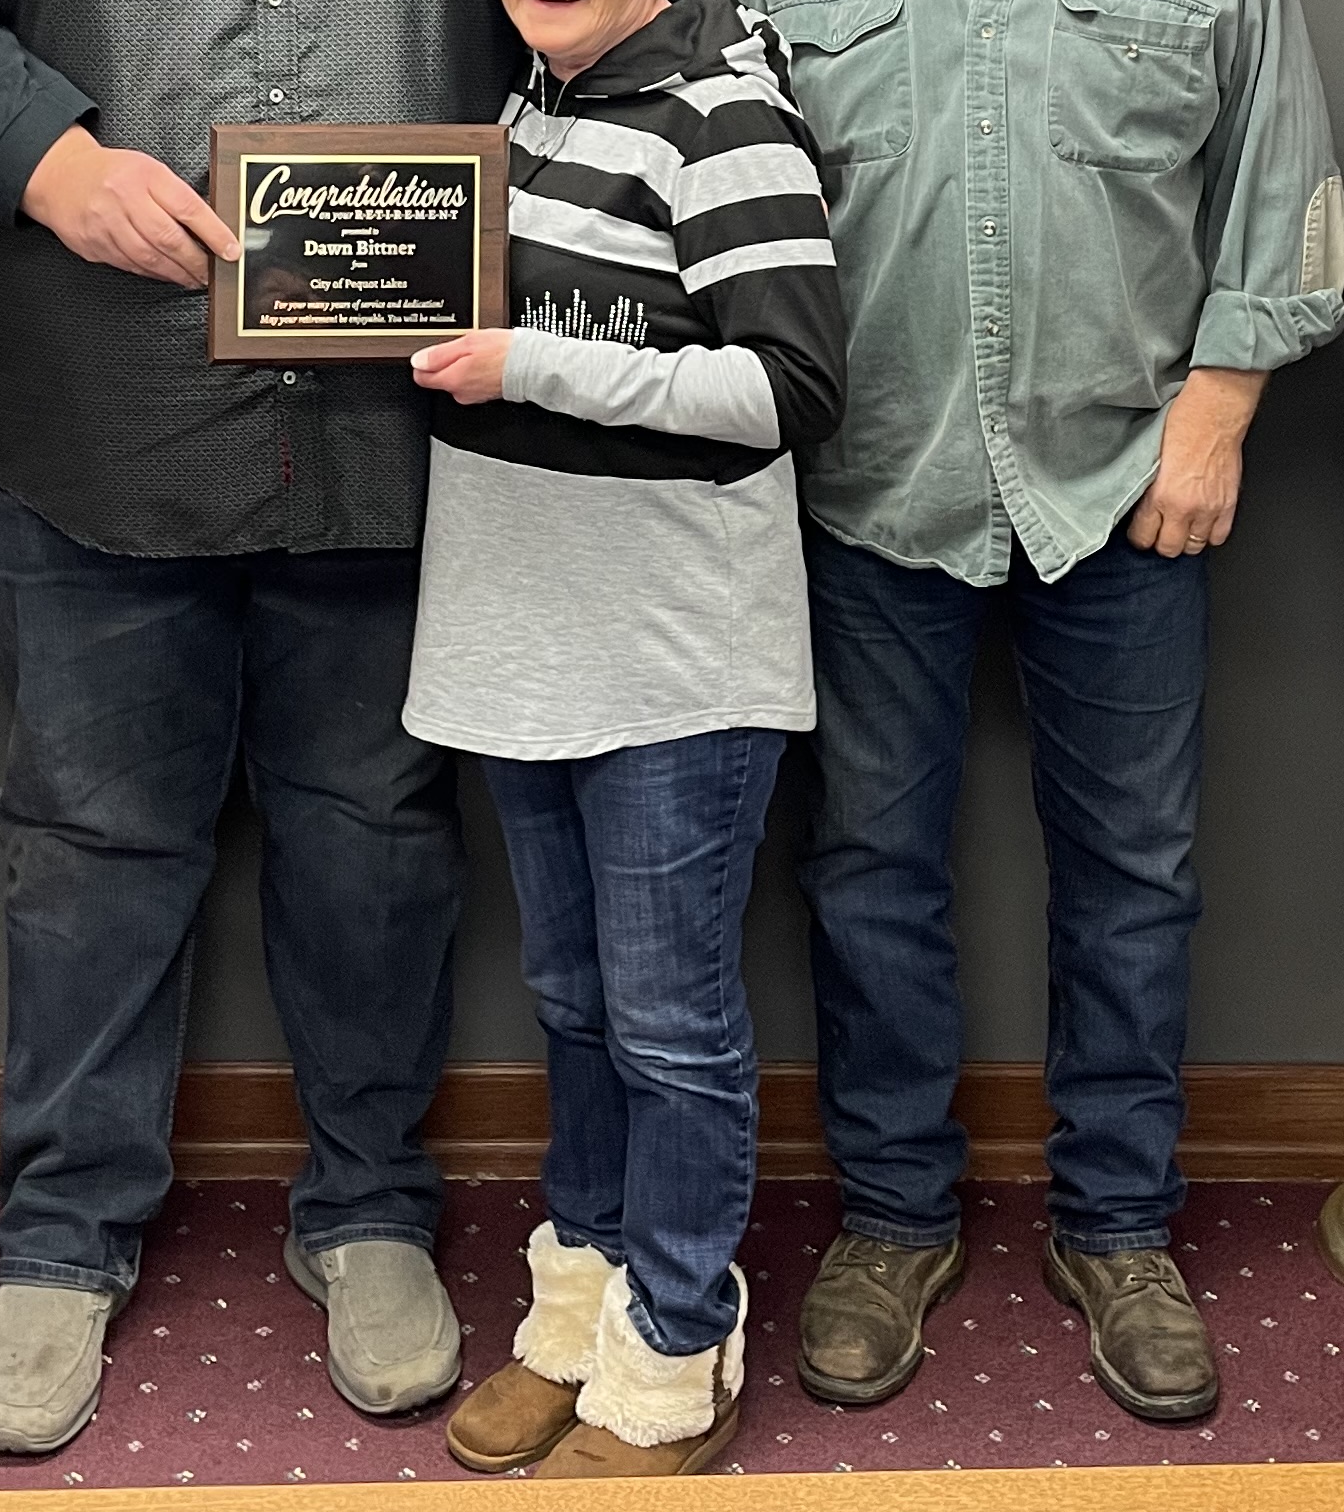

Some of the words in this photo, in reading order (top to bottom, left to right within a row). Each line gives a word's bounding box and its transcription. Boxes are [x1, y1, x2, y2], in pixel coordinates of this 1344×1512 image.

[249, 165, 467, 224] Congratulations
[318, 212, 331, 220] on
[331, 212, 354, 222] your
[303, 240, 353, 256] Dawn
[356, 239, 416, 256] Bittner
[350, 260, 368, 270] from
[309, 278, 332, 291] City
[332, 278, 345, 289] of
[345, 278, 378, 291] Pequot
[380, 278, 407, 289] Lakes
[273, 300, 288, 310] For
[287, 302, 307, 312] your
[307, 302, 330, 312] many
[329, 302, 351, 312] years
[351, 299, 362, 311] of
[386, 299, 402, 308] and
[260, 315, 279, 326] May
[277, 316, 299, 326] your
[338, 313, 348, 323] be
[387, 314, 402, 323] You
[403, 313, 418, 322] will
[419, 313, 428, 322] be
